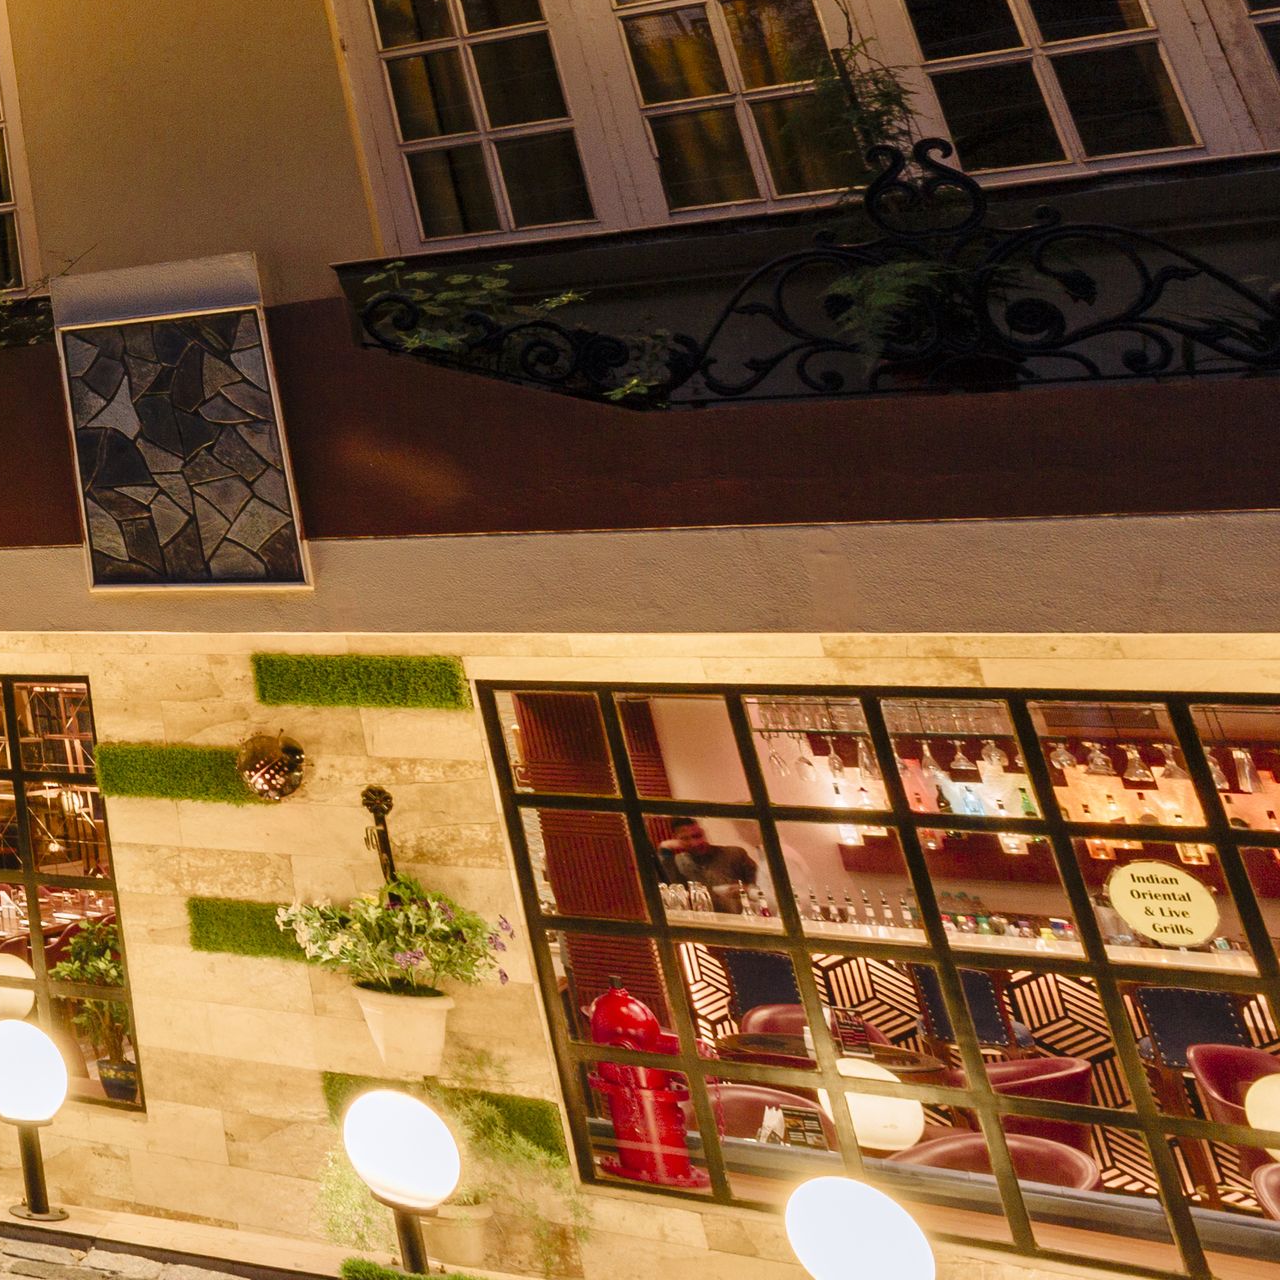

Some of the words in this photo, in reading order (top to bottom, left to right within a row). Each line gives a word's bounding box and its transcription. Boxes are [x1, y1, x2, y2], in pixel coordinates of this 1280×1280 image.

[1130, 873, 1179, 885] Indian
[1130, 889, 1192, 902] Oriental
[1144, 906, 1154, 916] &
[1159, 907, 1190, 918] Live
[1152, 923, 1194, 935] Grills
